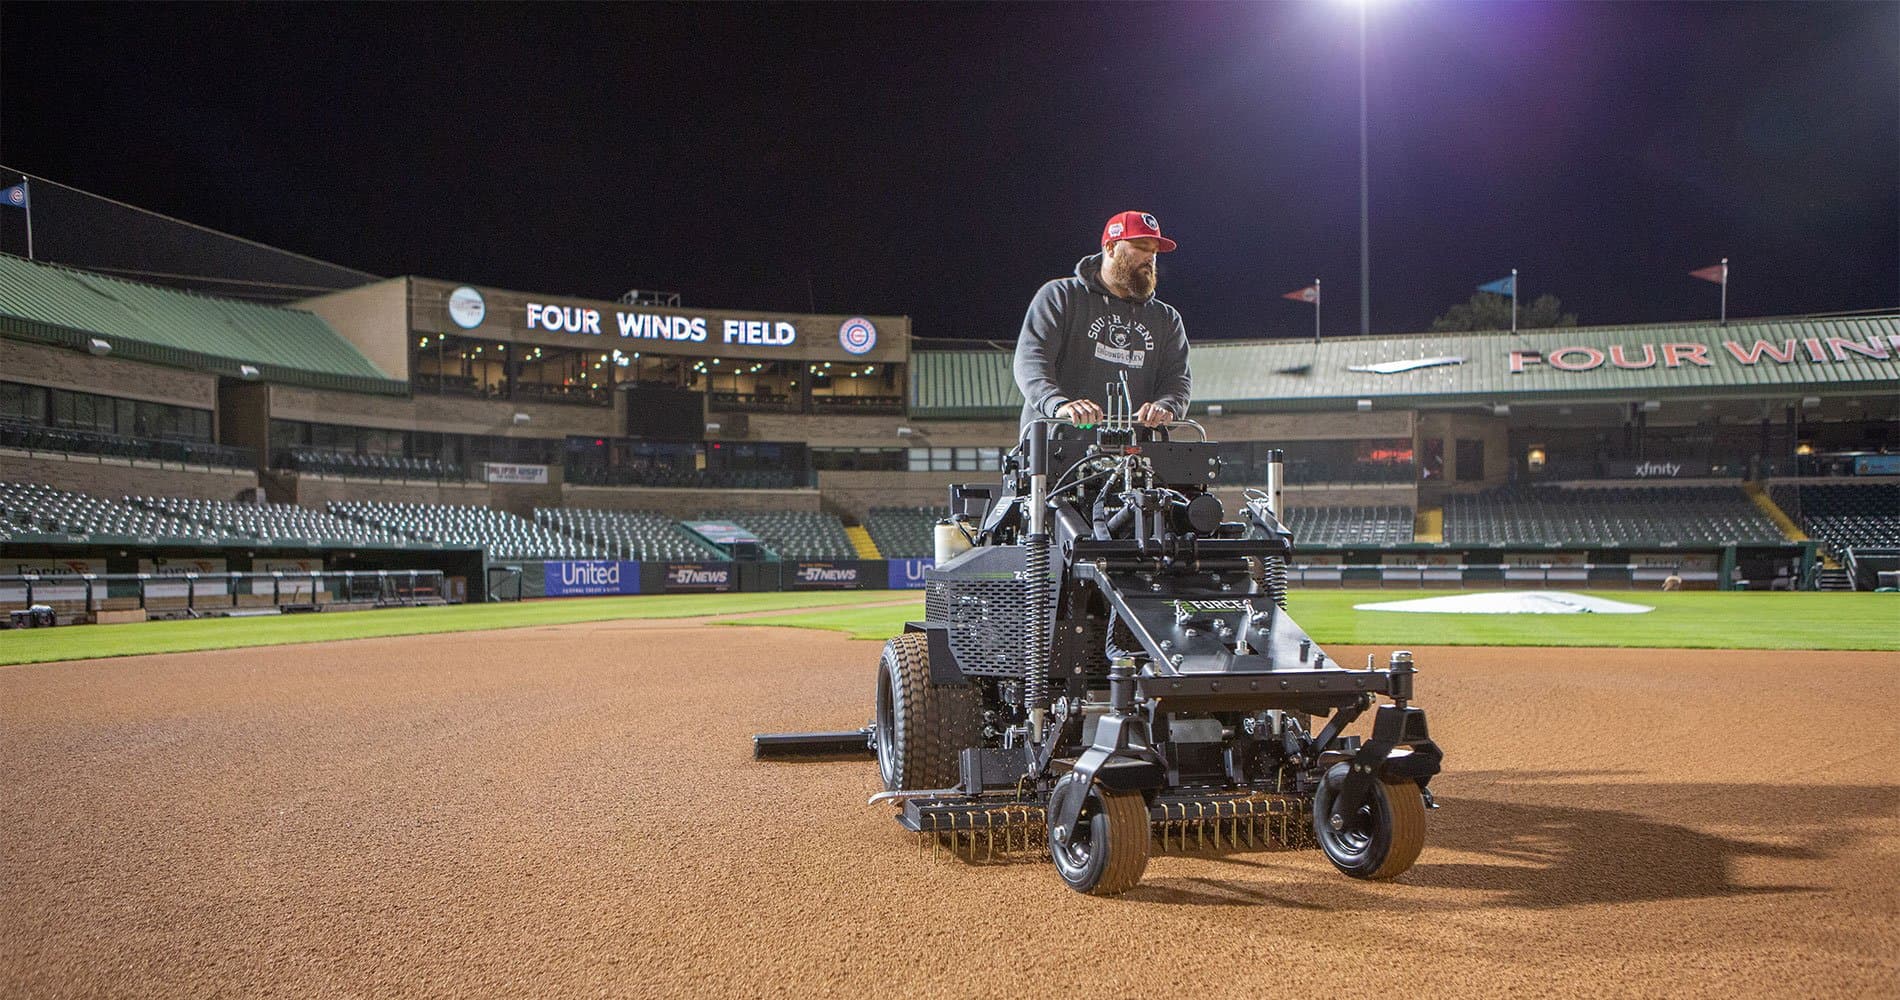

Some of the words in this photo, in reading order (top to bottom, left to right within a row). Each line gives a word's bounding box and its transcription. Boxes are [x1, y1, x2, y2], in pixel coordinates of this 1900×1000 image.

[527, 303, 600, 335] FOUR
[616, 312, 707, 342] WINDS
[723, 319, 796, 346] FIELD
[1088, 314, 1121, 340] SOUH
[1126, 320, 1154, 351] END
[1510, 343, 1712, 373] FOUR
[1723, 335, 1900, 365] WIN
[1636, 462, 1680, 476] xfinity
[562, 562, 619, 585] United
[1188, 600, 1245, 610] FORCE
